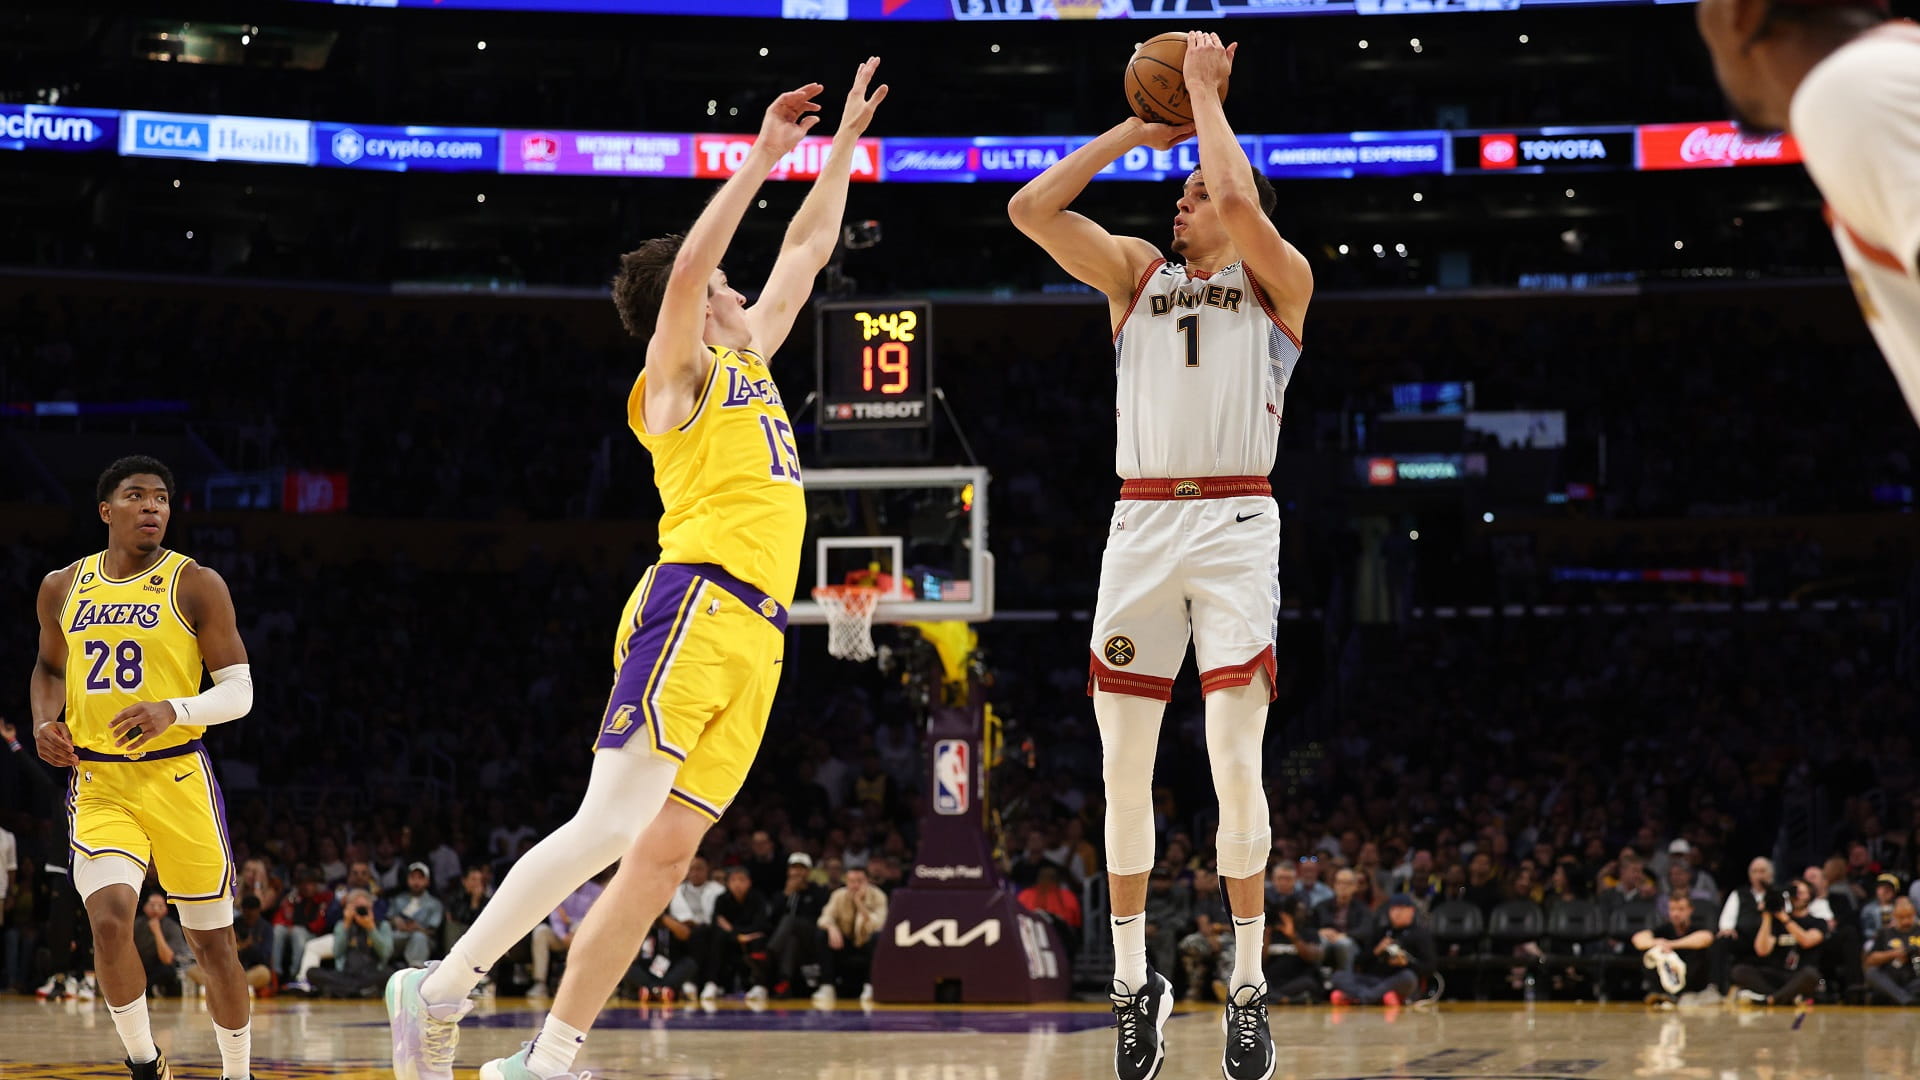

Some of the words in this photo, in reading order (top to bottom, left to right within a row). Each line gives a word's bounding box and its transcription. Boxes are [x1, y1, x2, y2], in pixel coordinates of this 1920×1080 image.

[143, 124, 201, 147] UCLA
[218, 127, 301, 153] Health
[366, 137, 482, 160] crypto.com
[1520, 140, 1606, 160] TOYOTA
[701, 141, 873, 174] TOHIA
[982, 149, 1060, 170] ULTRA
[855, 311, 917, 342] 7:42
[1177, 314, 1200, 367] 1
[863, 342, 908, 394] 19
[852, 401, 924, 419] TISSOT
[759, 414, 802, 485] 15
[143, 584, 166, 594] bibigo
[69, 599, 161, 633] LAKERS
[84, 639, 143, 692] 28
